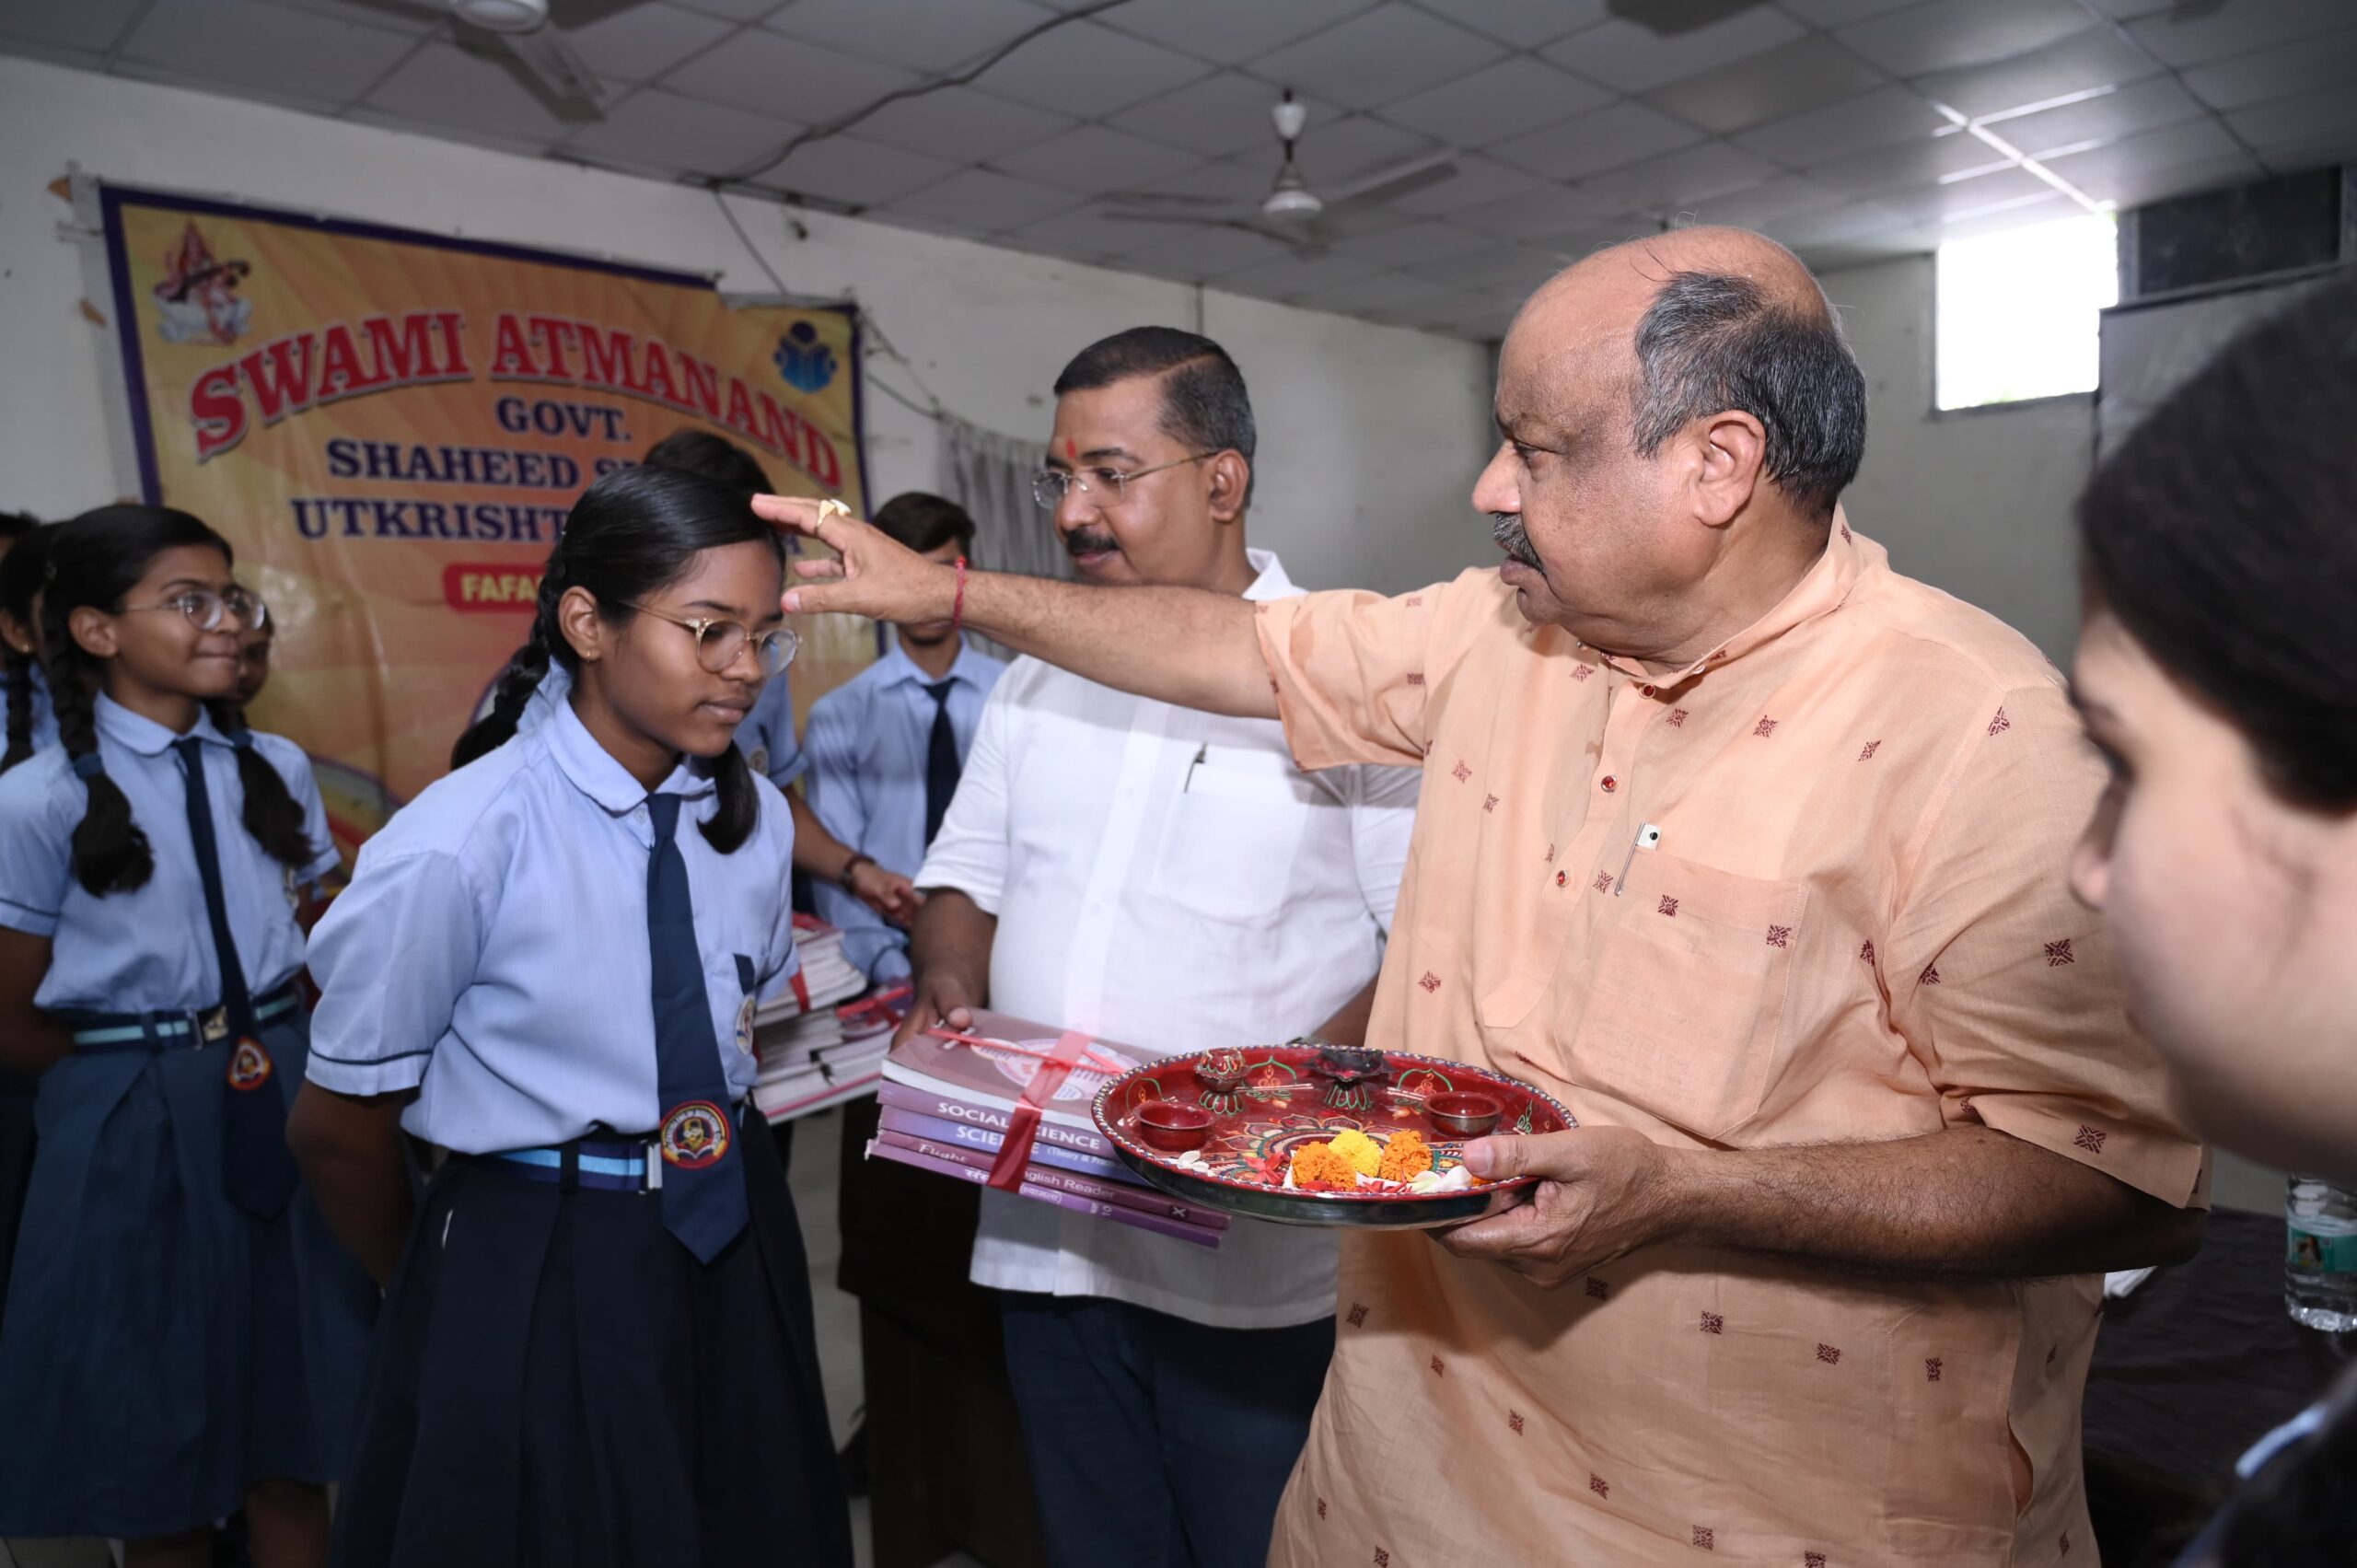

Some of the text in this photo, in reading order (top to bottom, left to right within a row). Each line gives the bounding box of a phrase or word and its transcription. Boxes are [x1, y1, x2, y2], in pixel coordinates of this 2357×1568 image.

[191, 311, 842, 494] SWAMI ATMANAND
[495, 397, 632, 442] GOVT.
[327, 438, 580, 489] SHAHEED
[459, 573, 545, 604] FAFA
[937, 1101, 1010, 1129] SOCIAL
[1063, 1178, 1116, 1198] Reader
[1172, 1205, 1187, 1219] X
